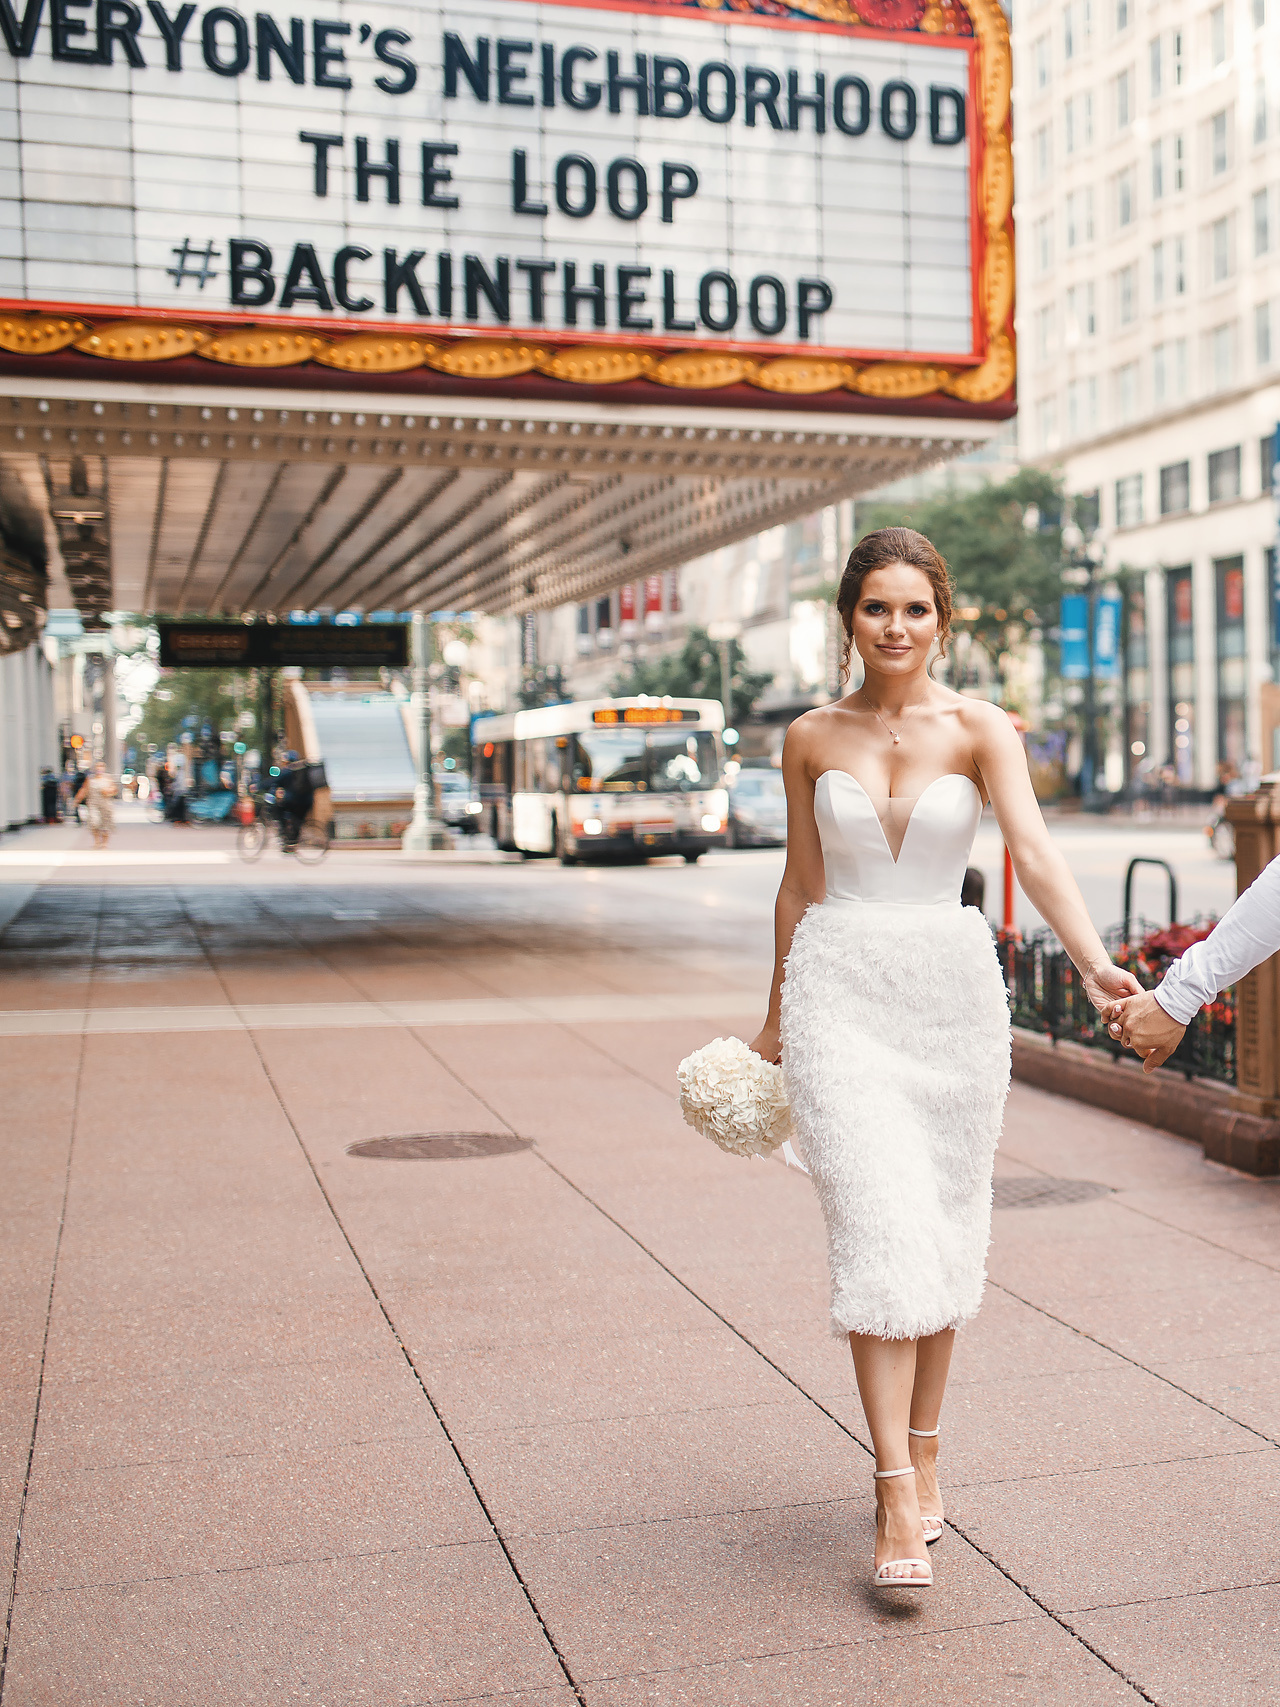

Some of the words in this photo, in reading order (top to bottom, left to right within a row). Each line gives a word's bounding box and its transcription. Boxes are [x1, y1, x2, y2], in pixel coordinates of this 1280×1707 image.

[442, 37, 968, 147] NEIGHBORHOOD
[300, 131, 462, 210] THE
[511, 148, 700, 224] LOOP
[166, 237, 834, 341] #BACKINTHELOOP
